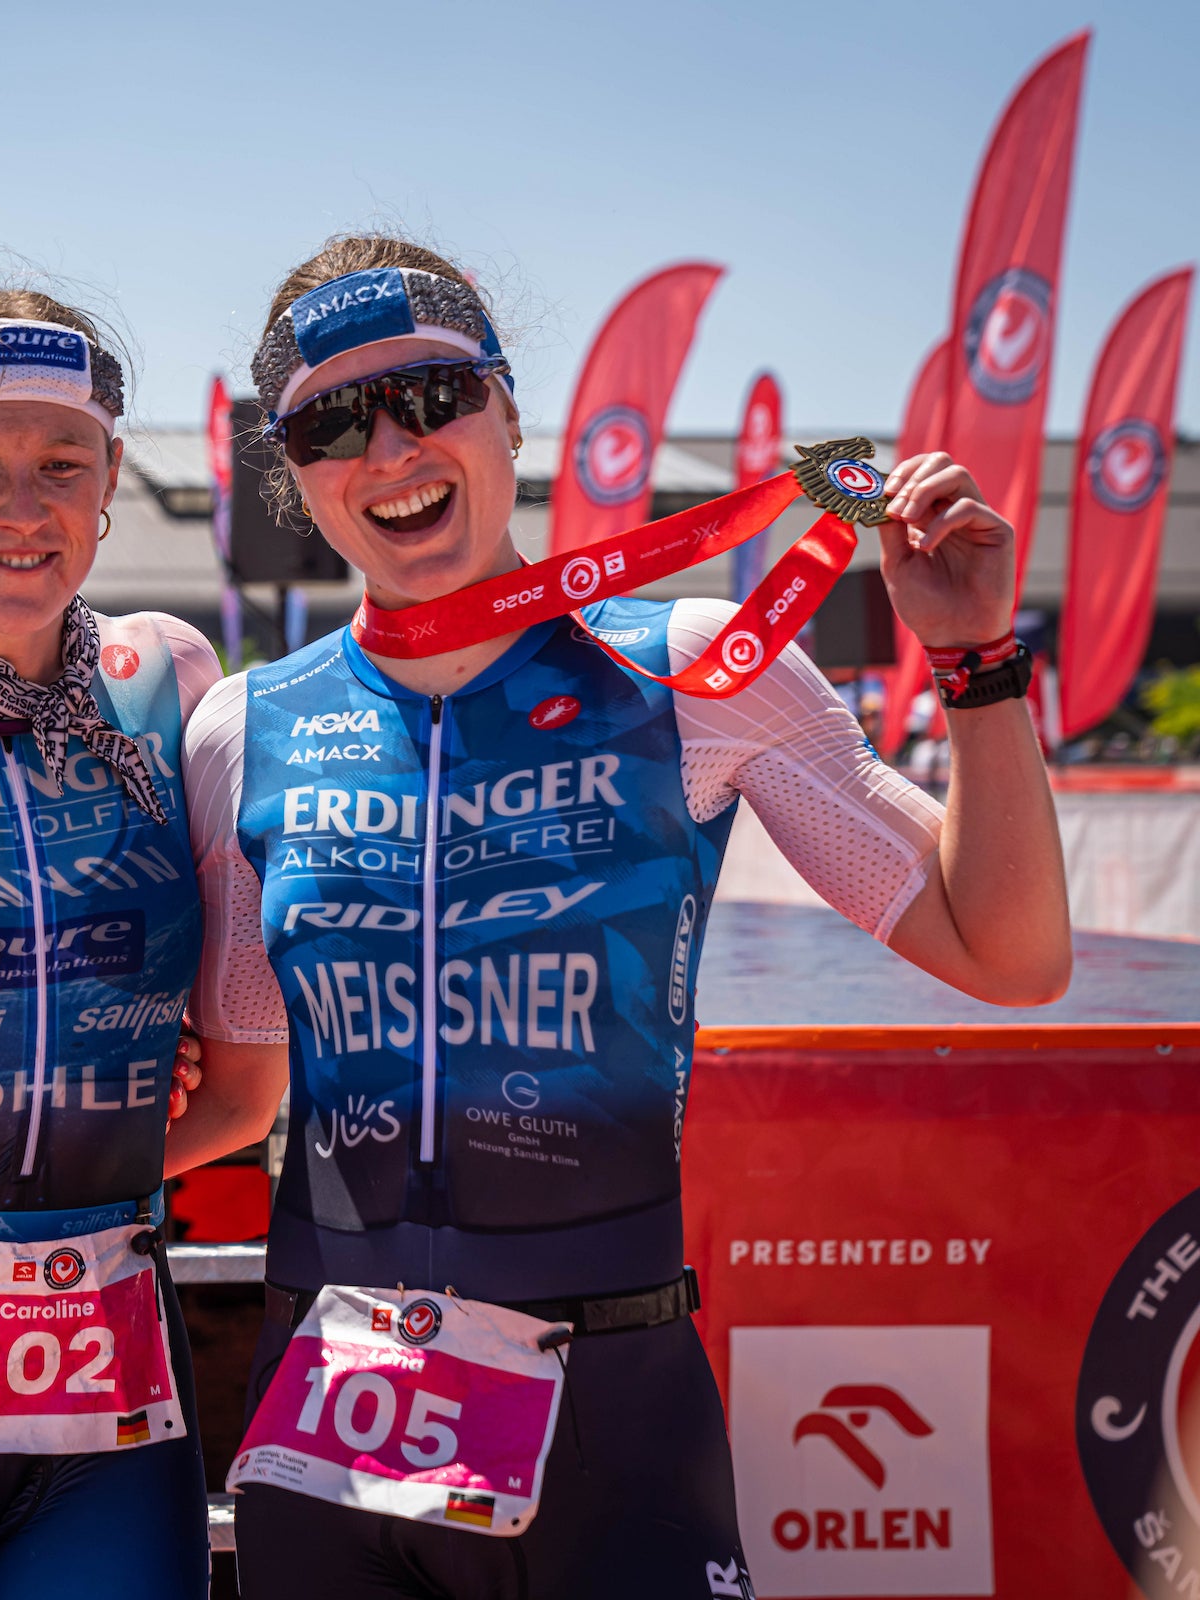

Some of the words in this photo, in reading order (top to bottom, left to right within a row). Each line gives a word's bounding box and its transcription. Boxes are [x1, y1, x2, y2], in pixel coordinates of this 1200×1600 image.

[305, 281, 393, 326] AMACX
[492, 585, 545, 614] 2026
[765, 576, 807, 627] 2026
[253, 683, 288, 698] BLUE
[290, 651, 343, 688] SEVENTY
[290, 710, 381, 738] HOKA
[286, 744, 382, 766] AMACX
[283, 754, 626, 840] ERDINGER
[281, 816, 616, 875] ALKOHOLFREI
[283, 882, 606, 932] RIDLEY
[73, 989, 189, 1040] sailfish
[293, 953, 599, 1059] MEISSNER
[466, 1107, 512, 1128] OWE
[519, 1115, 578, 1138] GLUTH
[672, 1046, 686, 1163] AMACX
[468, 1139, 511, 1158] Heizung
[513, 1147, 549, 1162] Sanitär
[551, 1154, 580, 1167] Klima
[507, 1133, 540, 1146] GmbH
[60, 1210, 124, 1235] sailfish
[729, 1240, 933, 1266] PRESENTED
[947, 1239, 992, 1265] BY
[1126, 1233, 1200, 1321] THE
[0, 1299, 96, 1321] Caroline
[150, 1385, 162, 1396] M
[296, 1365, 464, 1469] 105
[508, 1475, 522, 1490] M
[772, 1508, 951, 1552] ORLEN
